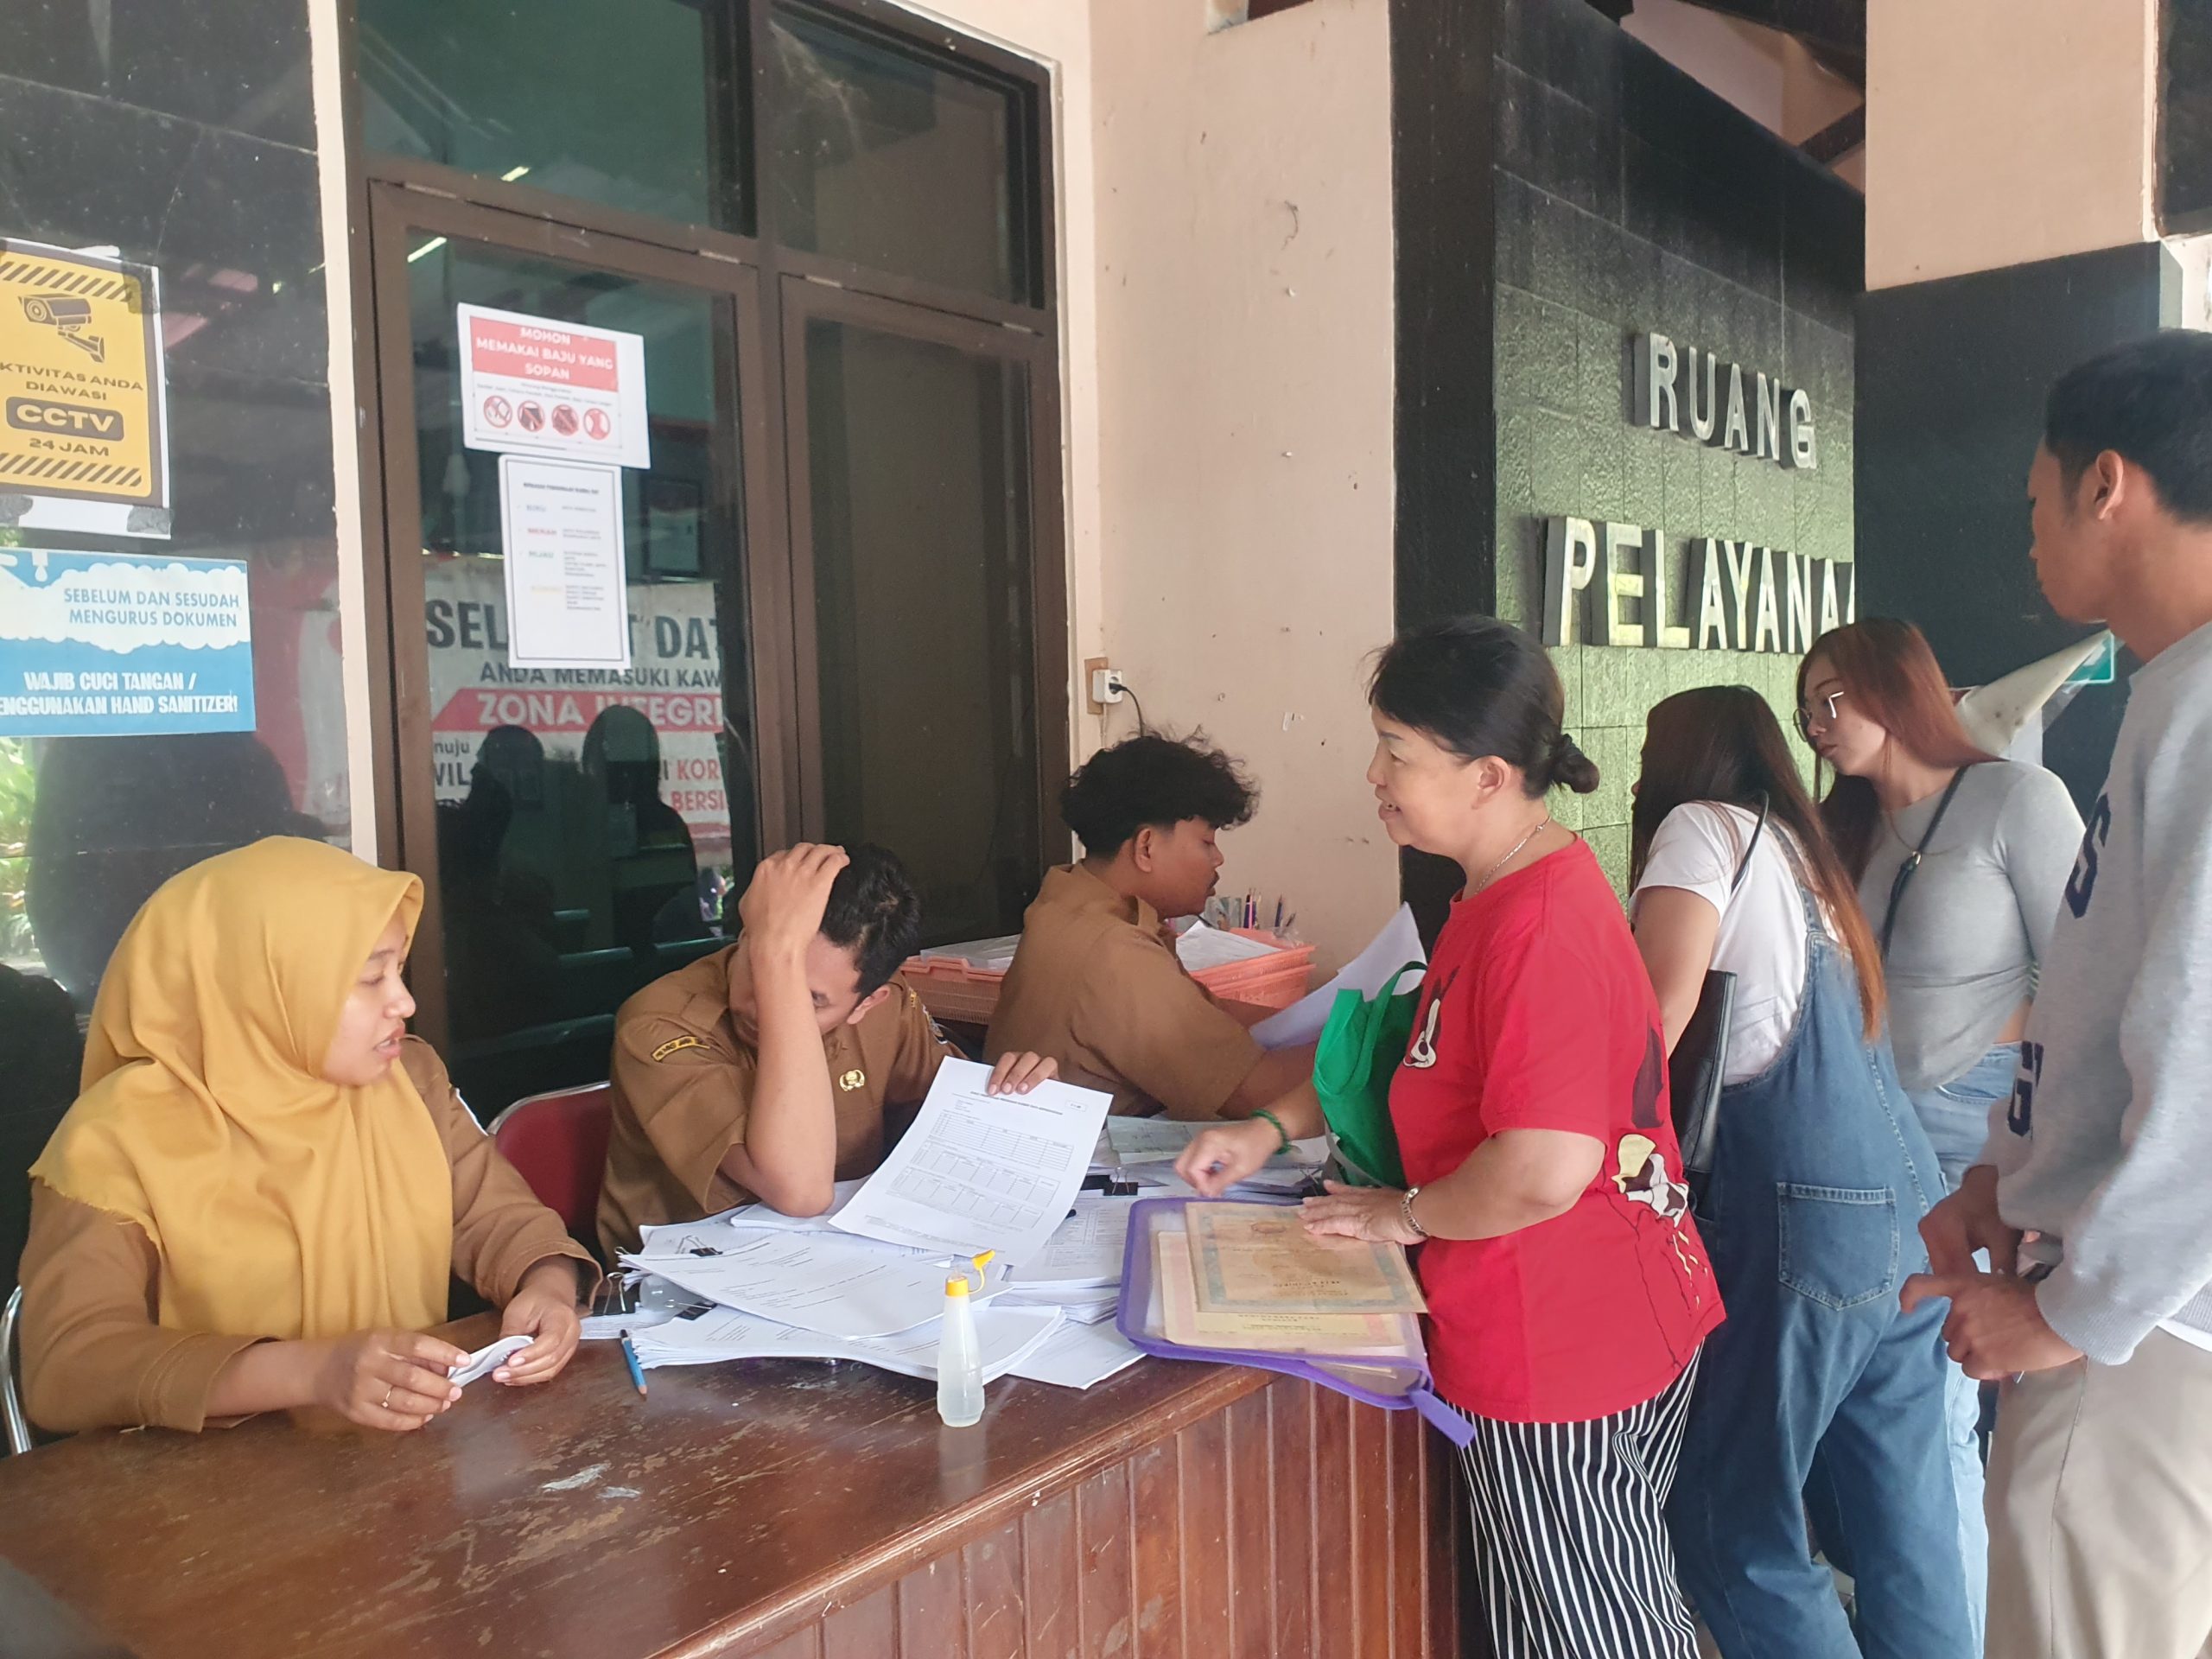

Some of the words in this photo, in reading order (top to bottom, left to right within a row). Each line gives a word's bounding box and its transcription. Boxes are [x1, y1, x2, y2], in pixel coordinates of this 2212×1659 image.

[520, 327, 571, 345] MOHON
[476, 337, 539, 357] MEMAKAI
[542, 348, 576, 364] BAJU
[580, 355, 613, 370] YANG
[524, 363, 570, 380] SOPAN
[26, 381, 107, 401] DIAWASI
[91, 375, 144, 391] ANDA
[1649, 332, 1816, 470] RUANG
[16, 404, 114, 433] CCTV
[29, 438, 55, 450] 24
[60, 442, 110, 456] JAM
[1560, 516, 1855, 655] PELAYANA
[64, 588, 132, 605] SEBELUM
[137, 591, 171, 606] DAN
[175, 593, 239, 608] SESUDAH
[69, 608, 158, 626] MENGURUS
[162, 612, 237, 626] DOKUMEN
[655, 615, 718, 660] DA
[23, 671, 75, 691] WAJIB
[79, 672, 118, 691] CUCI
[122, 672, 184, 691] TANGAN
[188, 672, 197, 690] /
[480, 661, 547, 683] ANDA
[554, 667, 670, 687] MEMASUKI
[111, 696, 155, 715] HAND
[477, 694, 585, 727] ZONA
